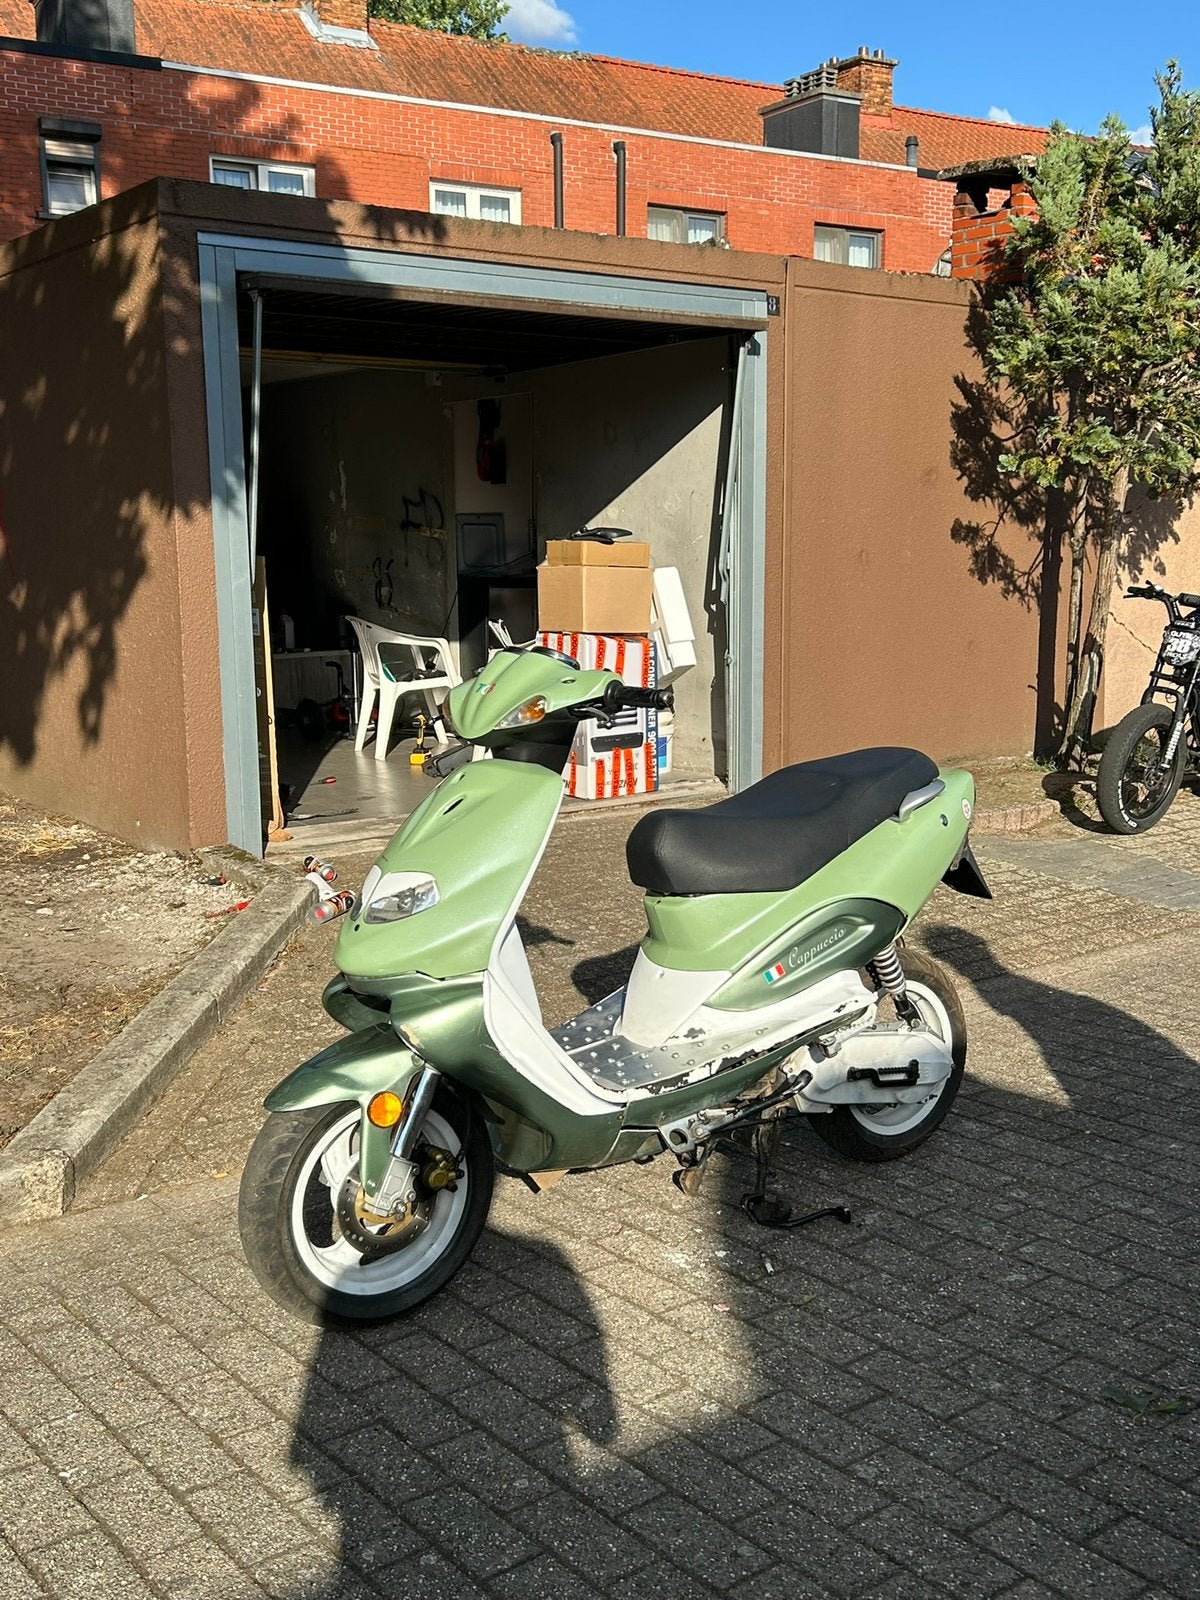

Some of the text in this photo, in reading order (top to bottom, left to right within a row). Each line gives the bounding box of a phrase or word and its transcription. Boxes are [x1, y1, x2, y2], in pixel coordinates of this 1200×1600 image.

[769, 296, 777, 311] 8
[1166, 638, 1191, 654] 38
[788, 928, 846, 968] Cappuccio
